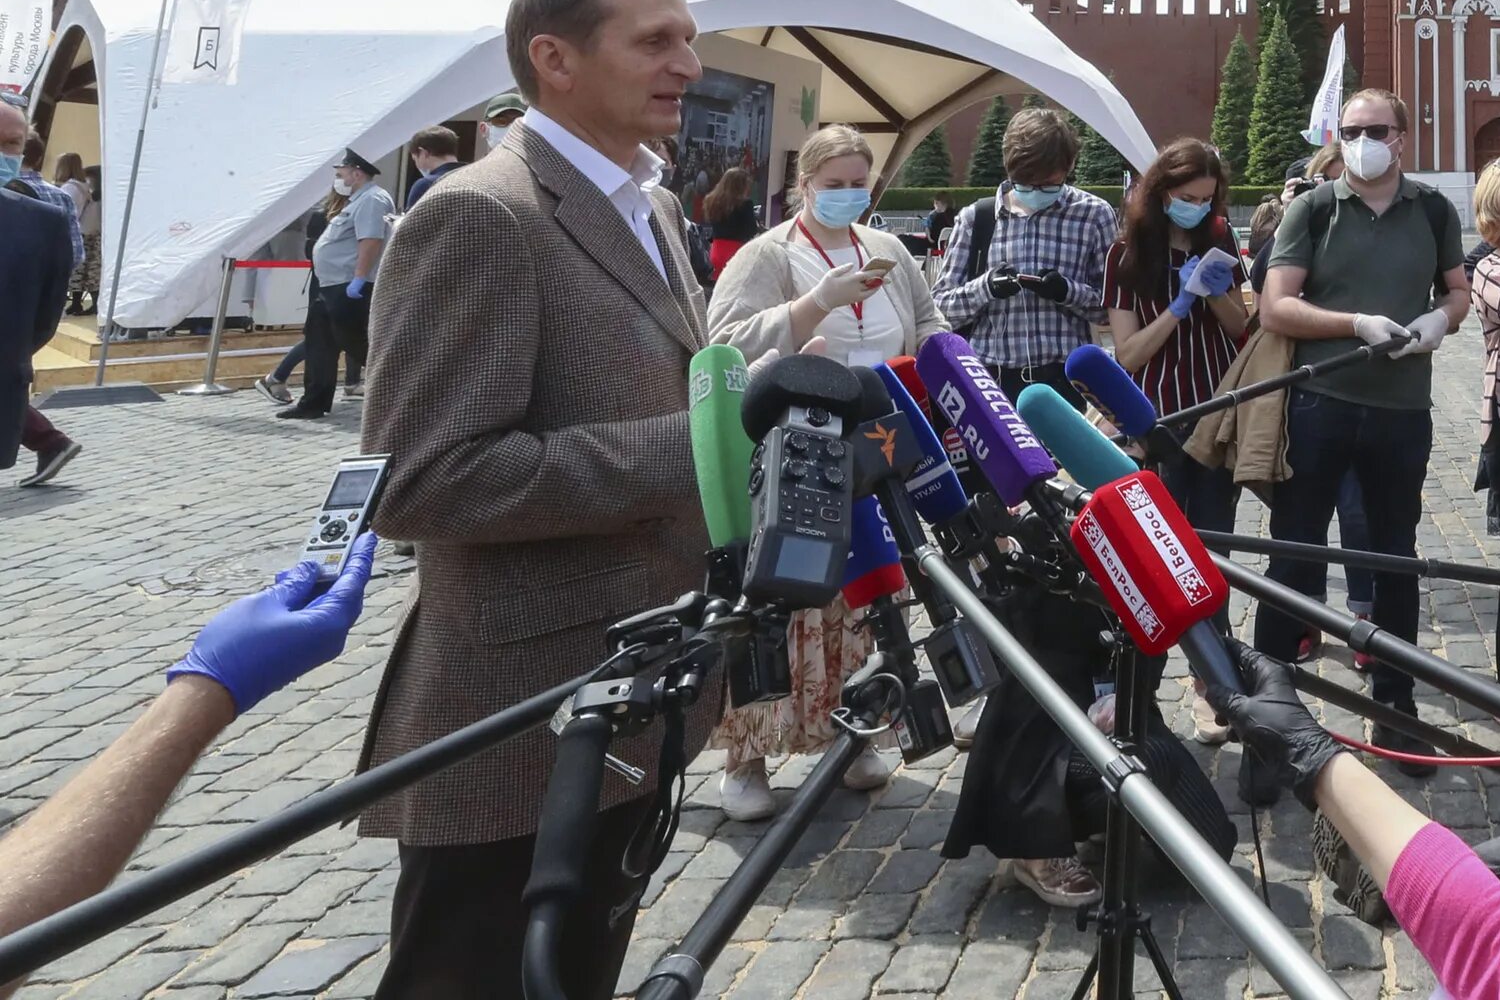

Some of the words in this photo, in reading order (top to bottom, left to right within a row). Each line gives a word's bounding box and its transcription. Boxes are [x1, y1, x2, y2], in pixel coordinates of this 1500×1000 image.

[30, 6, 43, 41] Москвы
[8, 31, 24, 74] культуры
[24, 43, 39, 75] города
[205, 39, 213, 51] Б
[956, 355, 1040, 449] ИЗВЕСТИЯ
[913, 480, 942, 501] 1TV.RU
[1144, 510, 1186, 569] БелРос
[1100, 544, 1138, 606] БелРос
